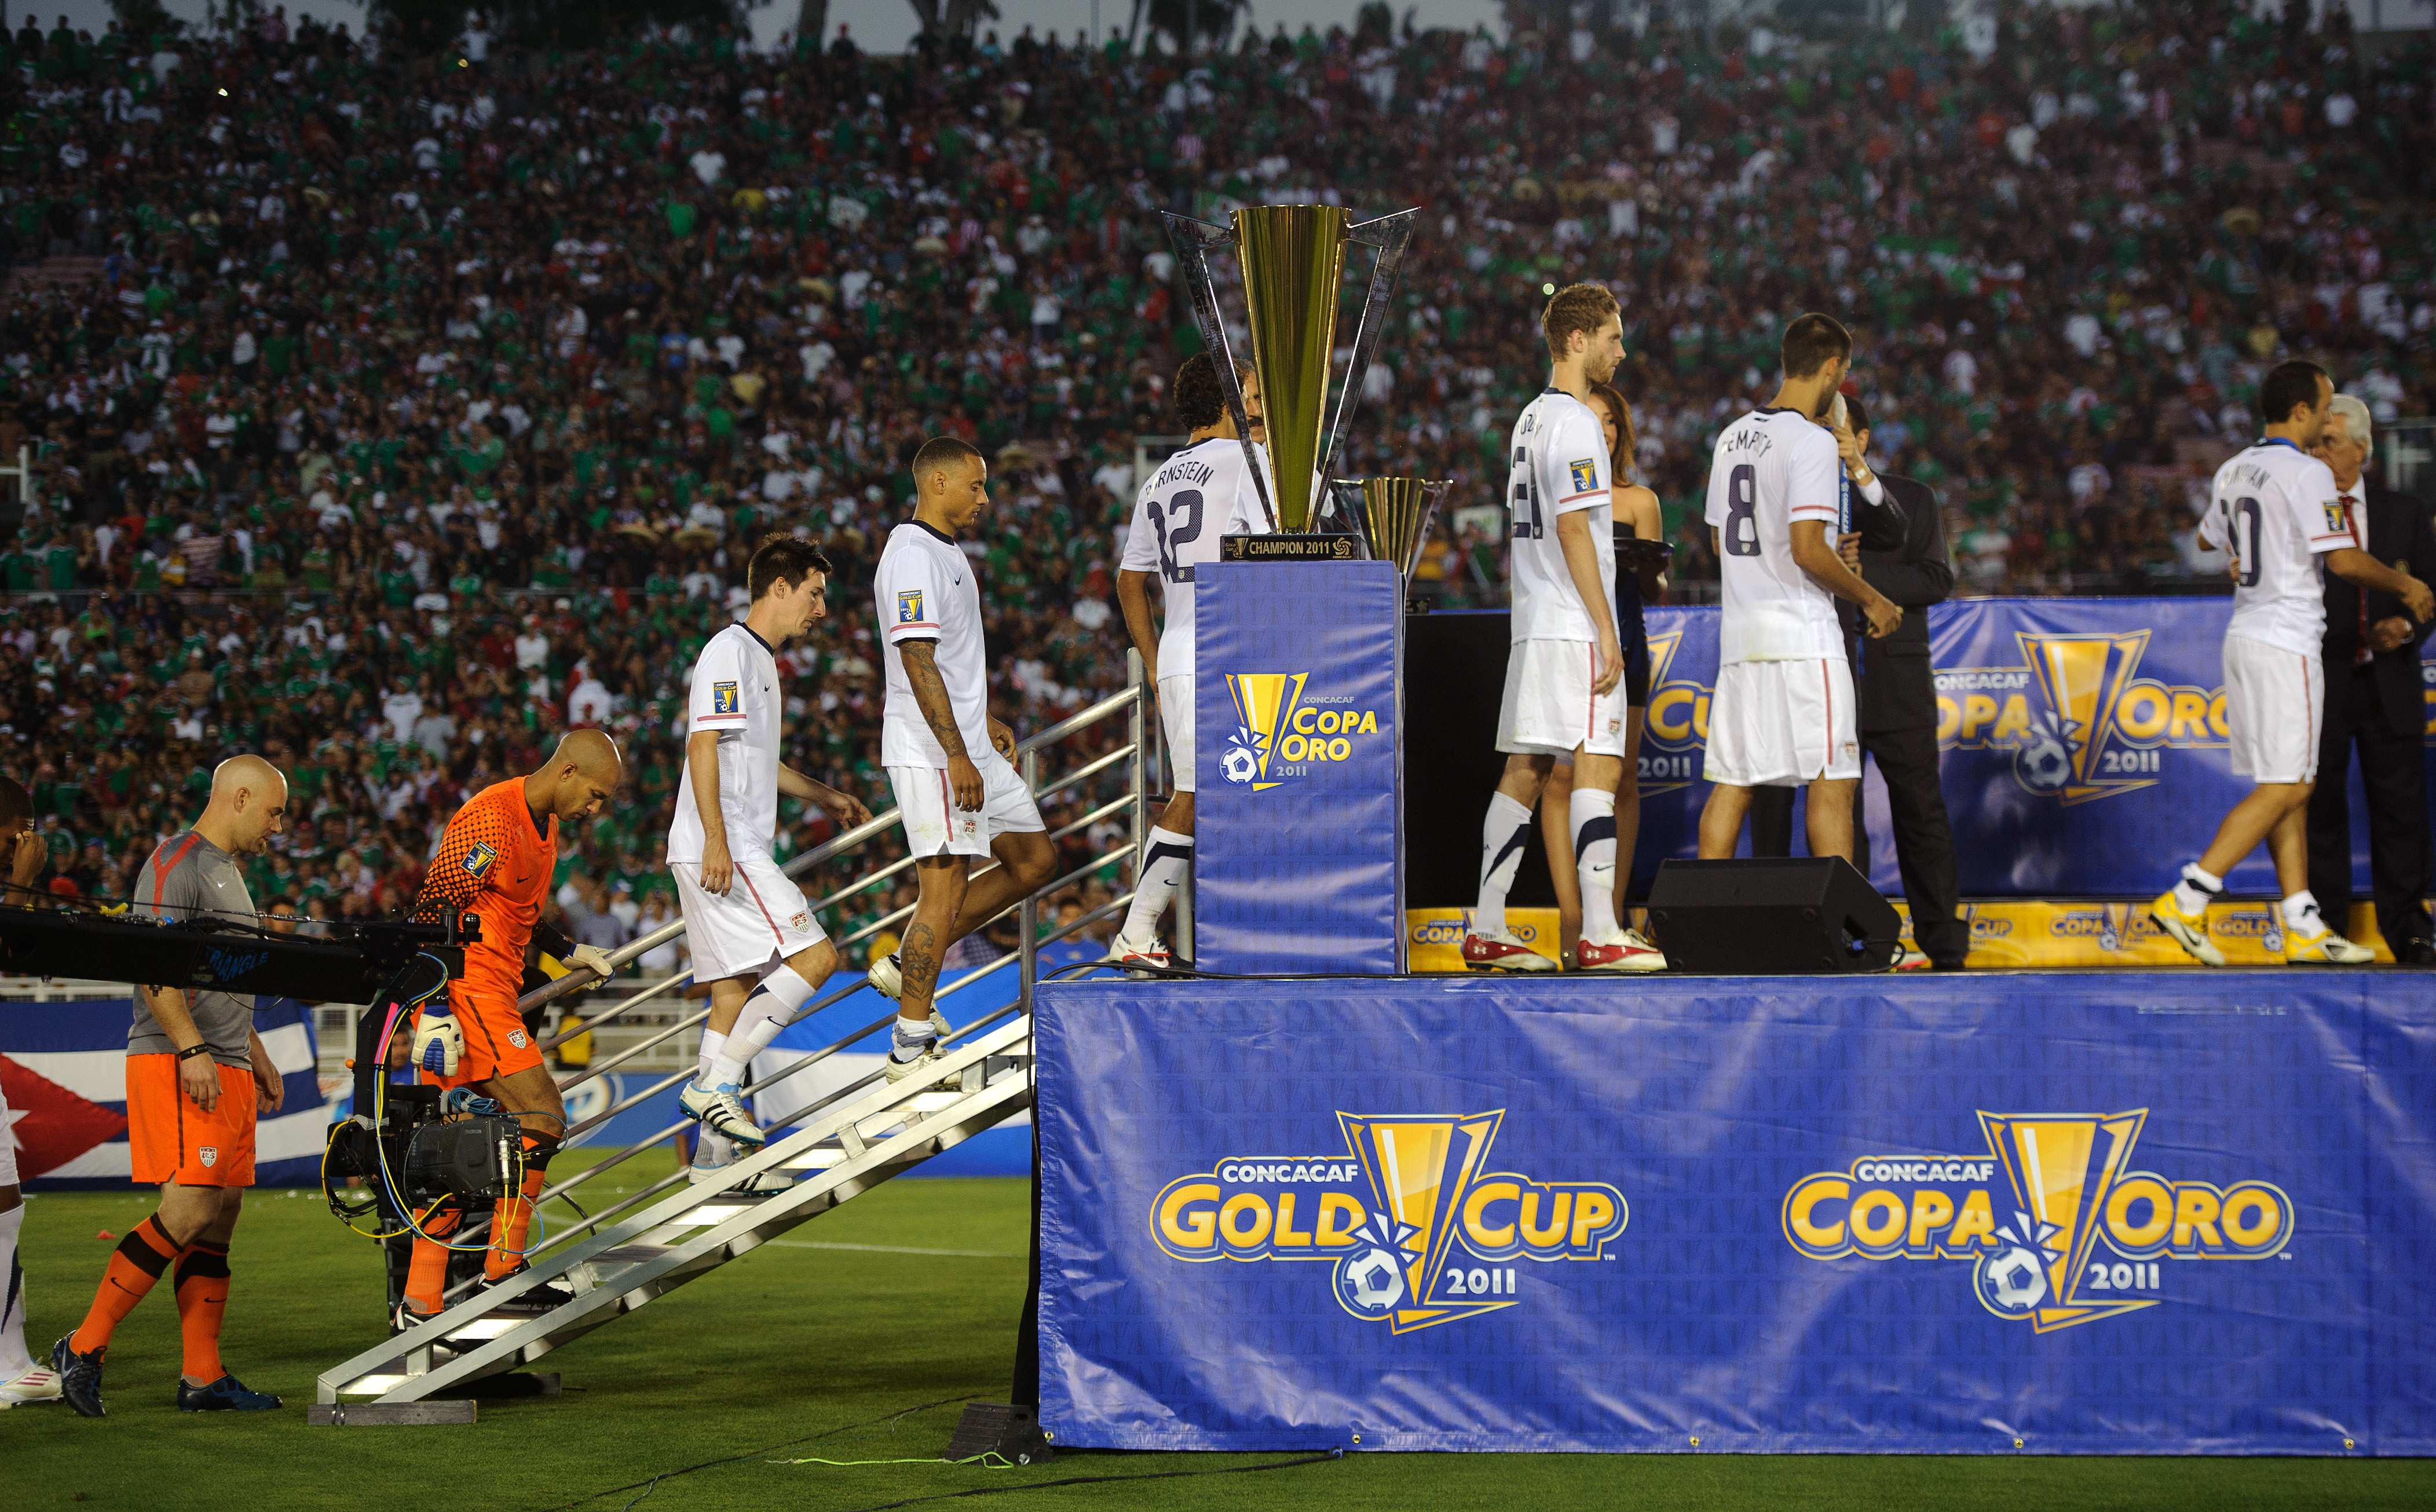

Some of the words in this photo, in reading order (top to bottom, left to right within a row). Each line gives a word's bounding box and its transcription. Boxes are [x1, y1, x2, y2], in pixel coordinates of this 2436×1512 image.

[1725, 464, 1762, 556] 8
[1147, 490, 1203, 583] 12
[1249, 541, 1304, 554] CHAMPION
[1306, 541, 1329, 554] 2011
[1934, 672, 2031, 690] ONCACAF
[1292, 706, 1378, 734] COPA
[1937, 694, 2032, 741] OPA
[1281, 734, 1351, 762] ORO
[1276, 766, 1307, 777] 2011
[1638, 757, 1691, 777] 2011
[2103, 750, 2160, 773] 2011
[1413, 926, 1465, 943] COPA
[1971, 920, 2010, 937] CUP
[2051, 918, 2104, 936] COPA
[2216, 918, 2272, 935] GOLD
[1222, 1165, 1358, 1183] CONCACAF
[1859, 1162, 1994, 1182] CONCACAF
[1160, 1185, 1367, 1248] GOLD
[1463, 1184, 1615, 1247] CUP
[1791, 1180, 1998, 1248] COPA
[2106, 1178, 2281, 1248] ORO
[1446, 1268, 1516, 1295] 2011
[2089, 1263, 2160, 1290] 2011
